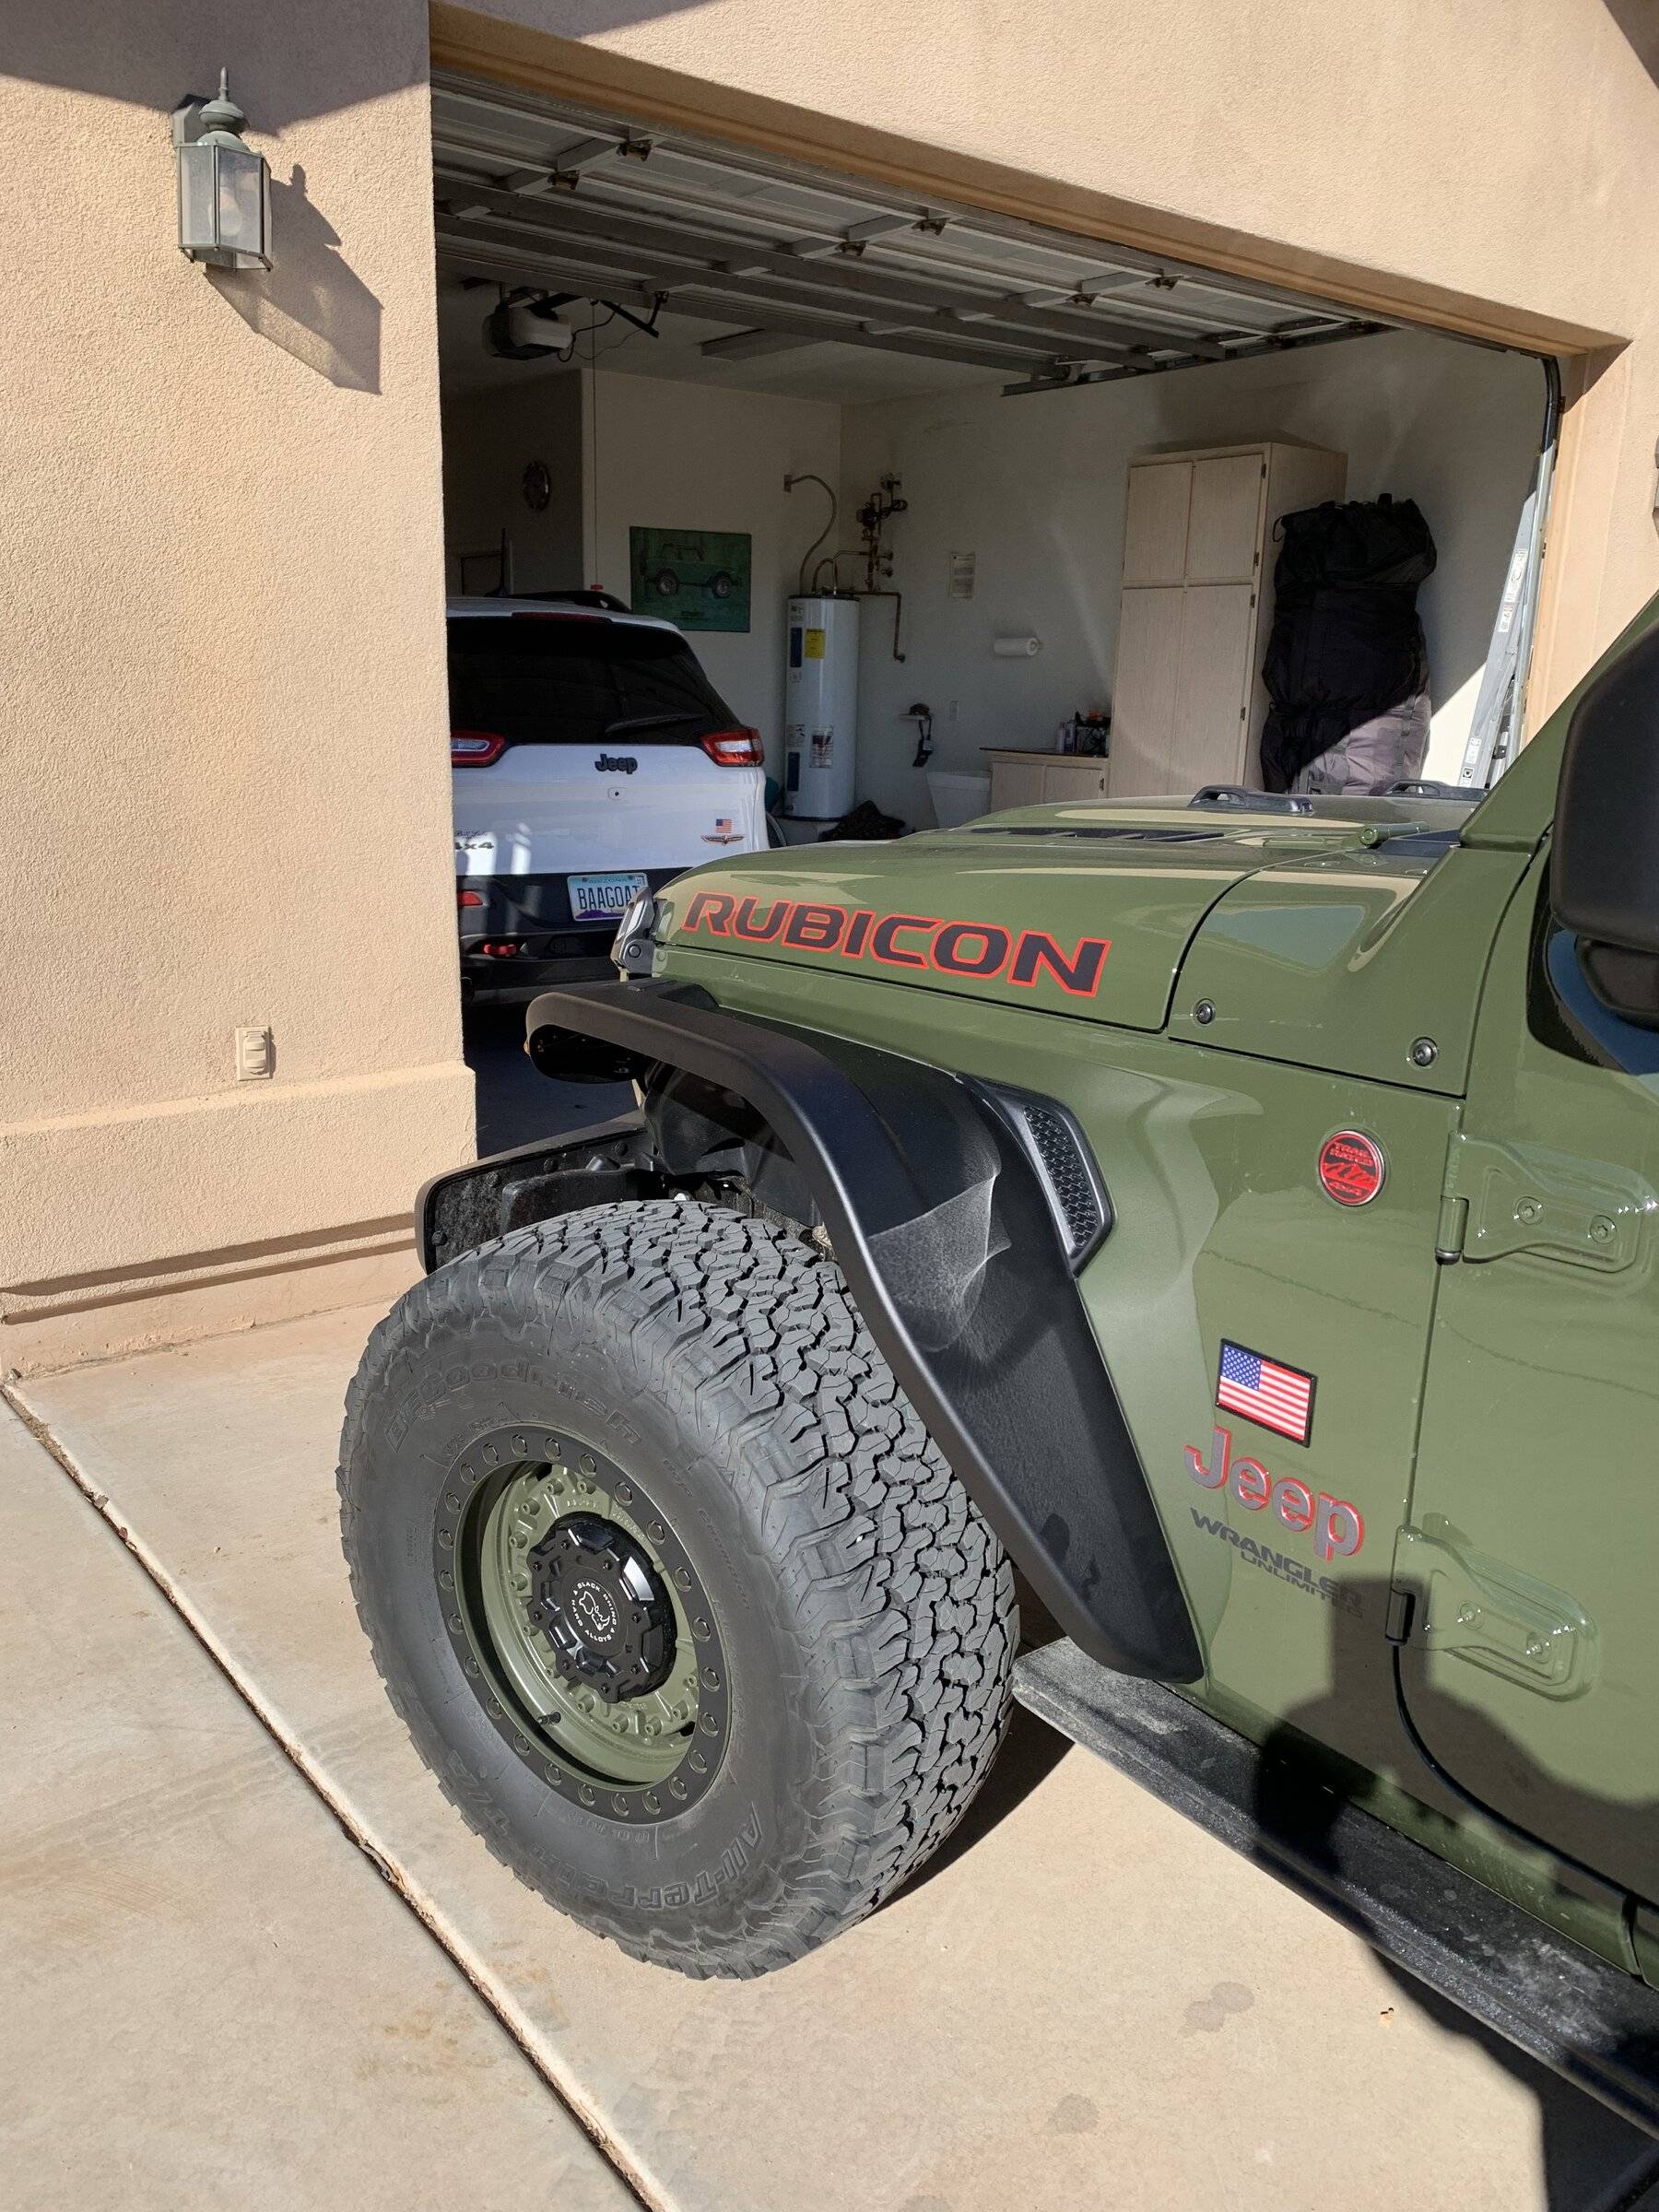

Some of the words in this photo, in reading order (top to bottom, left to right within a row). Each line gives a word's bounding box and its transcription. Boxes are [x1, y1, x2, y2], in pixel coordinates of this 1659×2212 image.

[594, 753, 638, 774] Jeep
[577, 885, 641, 910] BAAGOAT
[680, 890, 1112, 998] RUBICON
[1183, 1426, 1364, 1561] Jeep
[1191, 1507, 1362, 1607] WRANGLER
[1241, 1551, 1364, 1618] UNLIMITED
[577, 1581, 601, 1593] BLACK
[603, 1593, 617, 1626] RHINO
[584, 1629, 612, 1642] ALLOYS
